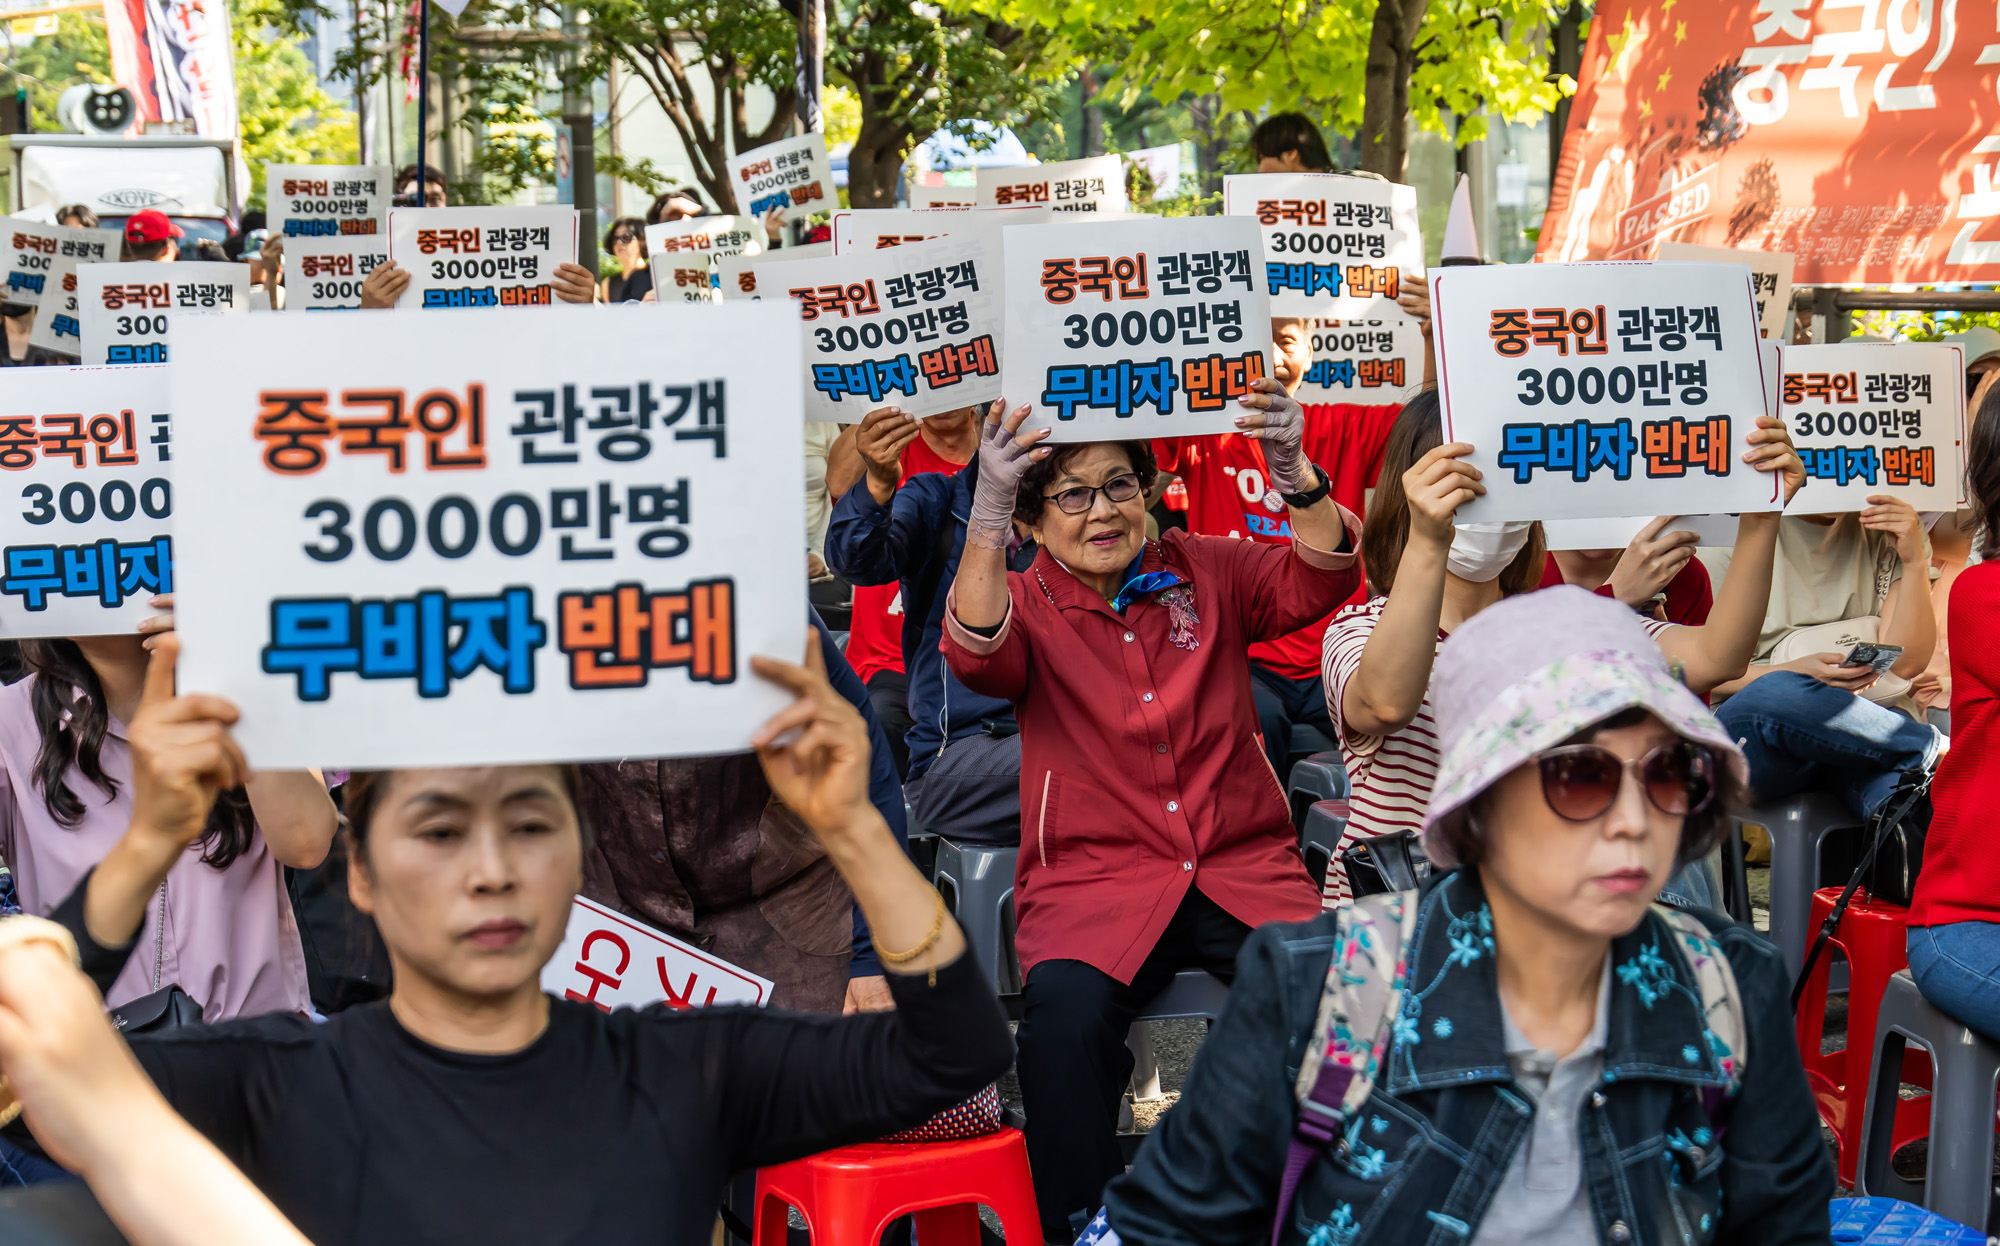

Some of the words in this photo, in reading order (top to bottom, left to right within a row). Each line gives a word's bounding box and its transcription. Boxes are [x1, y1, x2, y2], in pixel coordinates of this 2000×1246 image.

[1731, 0, 1957, 125] 중국인
[740, 158, 773, 182] 중국인
[775, 147, 814, 170] 관광객
[749, 165, 811, 195] 3000만명
[283, 179, 328, 196] 중국인
[333, 180, 376, 195] 관광객
[291, 199, 368, 215] 3000만명
[994, 181, 1049, 205] 중국인
[1054, 176, 1105, 200] 관광객
[283, 218, 338, 237] 무비자
[1256, 199, 1327, 227] 중국인
[1333, 202, 1394, 230] 관광객
[1623, 182, 1710, 244] PASSED
[12, 232, 57, 254] 중국인
[61, 239, 105, 259] 관광객
[417, 227, 481, 254] 중국인
[486, 227, 550, 251] 관광객
[1271, 231, 1386, 258] 3000만명
[301, 253, 354, 278] 중국인
[431, 255, 538, 279] 3000만명
[1040, 252, 1149, 305] 중국인
[1157, 249, 1254, 296] 관광객
[1266, 261, 1343, 297] 무비자
[1346, 264, 1400, 300] 반대
[102, 282, 171, 310] 중국인
[176, 283, 234, 308] 관광객
[789, 278, 881, 321] 중국인
[884, 260, 980, 309] 관광객
[814, 301, 970, 353] 3000만명
[1063, 300, 1244, 349] 3000만명
[1310, 330, 1394, 353] 000만명
[1489, 305, 1608, 357] 중국인
[1617, 306, 1723, 352] 관광객
[811, 353, 919, 402] 무비자
[918, 333, 999, 390] 반대
[1041, 356, 1179, 421] 무비자
[1182, 350, 1266, 413] 반대
[1302, 357, 1356, 389] 비자
[1358, 357, 1405, 388] 반대
[1517, 359, 1709, 406] 3000만명
[1784, 371, 1859, 404] 중국인
[1864, 373, 1932, 404] 관광객
[0, 409, 139, 471] 중국인
[253, 381, 488, 476] 중국인
[509, 378, 729, 465] 관광객
[1795, 409, 1922, 438] 3000만명
[1498, 418, 1638, 484] 무비자
[1641, 415, 1731, 479] 반대
[1882, 445, 1935, 487] 반대
[302, 477, 693, 565] 3000만명
[0, 535, 173, 611] 무비자
[261, 583, 547, 703] 무비자
[557, 576, 739, 692] 반대
